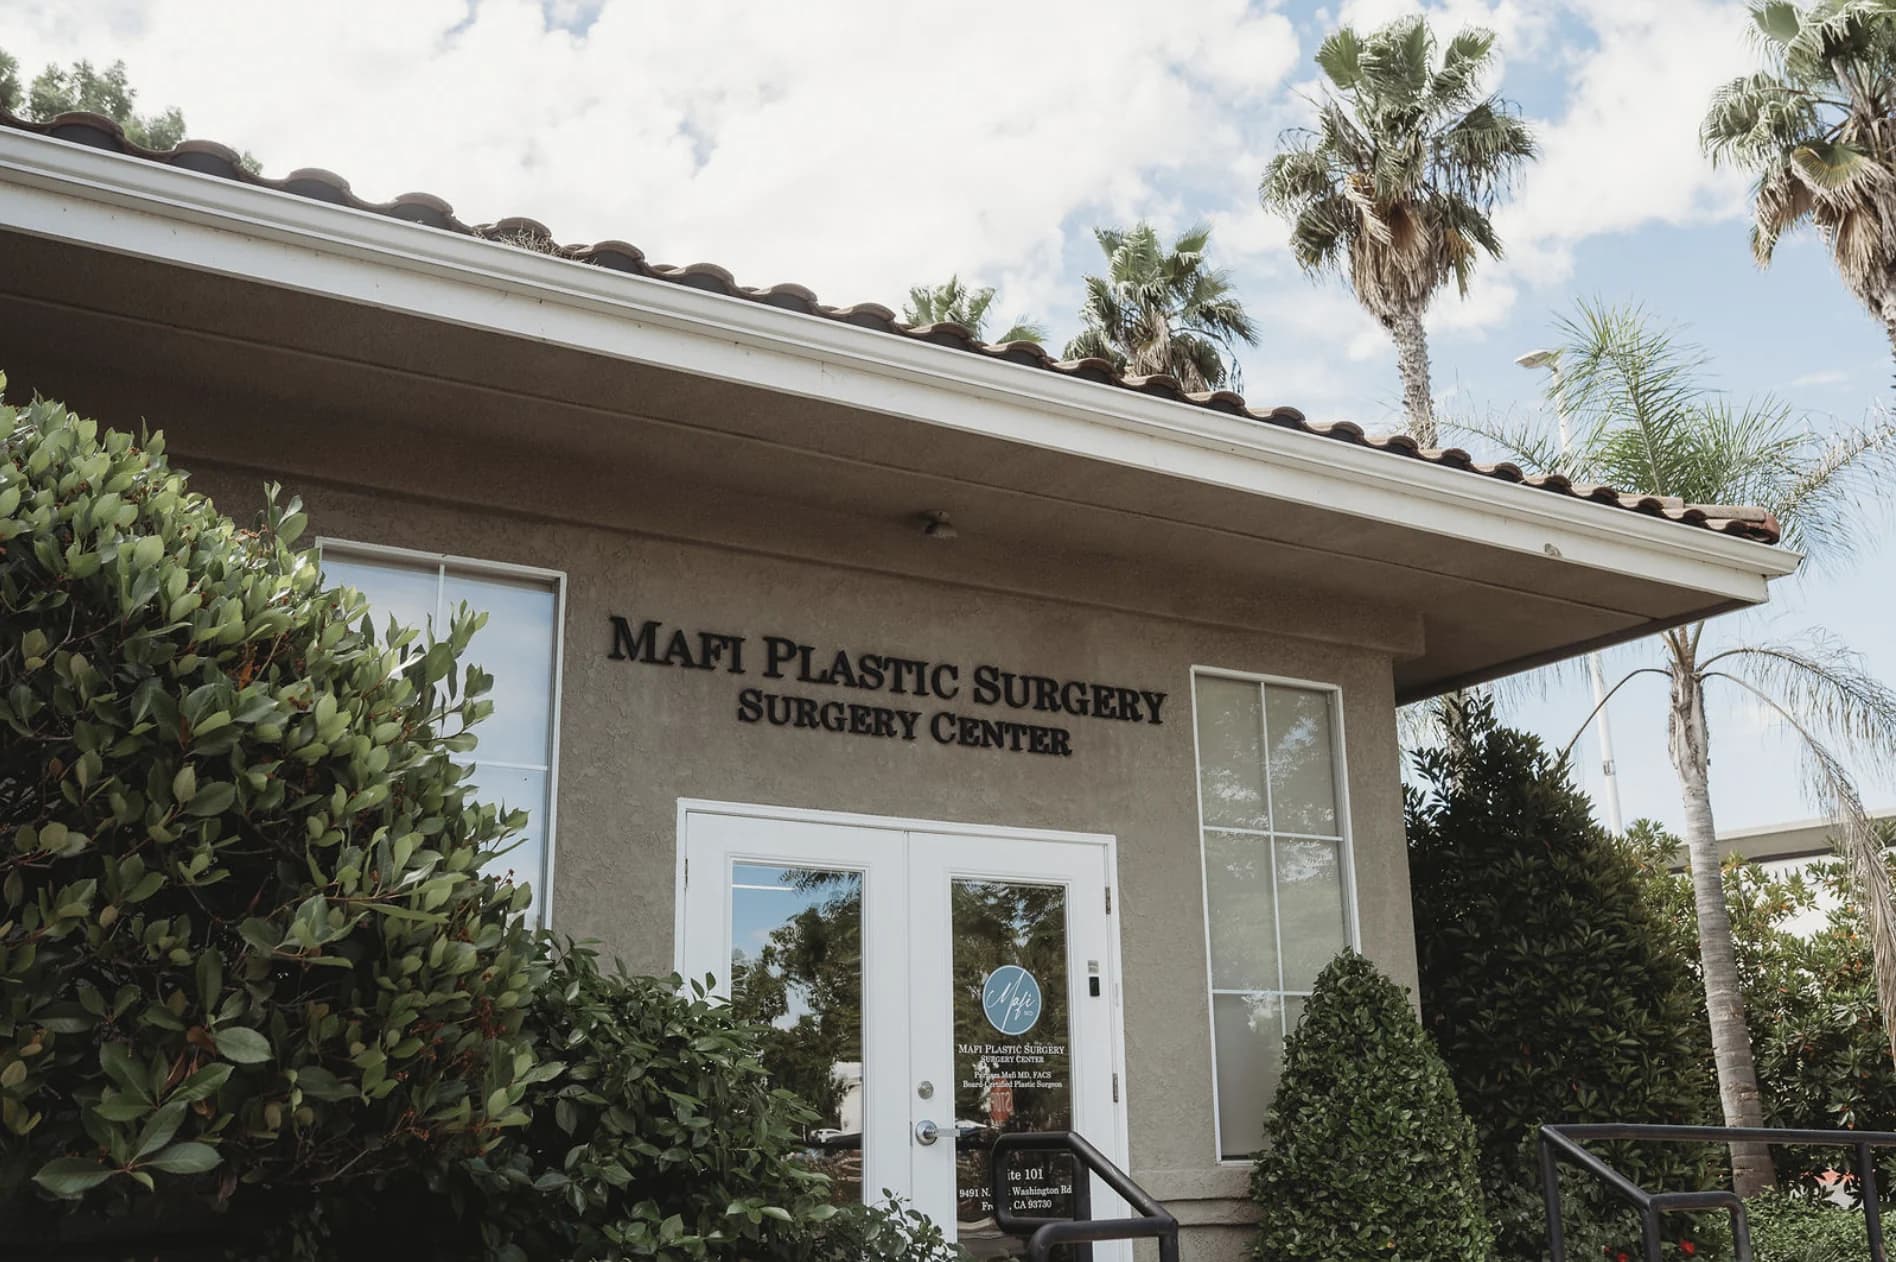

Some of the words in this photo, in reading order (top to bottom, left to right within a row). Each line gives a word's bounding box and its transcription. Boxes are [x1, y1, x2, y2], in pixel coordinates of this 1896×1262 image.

[607, 615, 746, 674] MAFI
[762, 636, 959, 700] PLASTIC
[973, 665, 1168, 725] SURGERY
[738, 688, 922, 740] SURGERY
[930, 712, 1072, 757] CENTER
[958, 1043, 982, 1054] MAFI
[985, 1044, 1022, 1055] PLASTIC
[1024, 1043, 1064, 1056] SURGERY
[981, 1055, 1014, 1063] SURGERY
[1016, 1055, 1044, 1063] CENTER
[1014, 1080, 1036, 1088] Plastic
[1036, 1080, 1063, 1089] Surgeon
[1025, 1168, 1044, 1180] 101
[959, 1188, 979, 1198] 9491
[1012, 1186, 1060, 1197] Washington
[1060, 1184, 1072, 1194] Rd
[1013, 1200, 1026, 1209] CA
